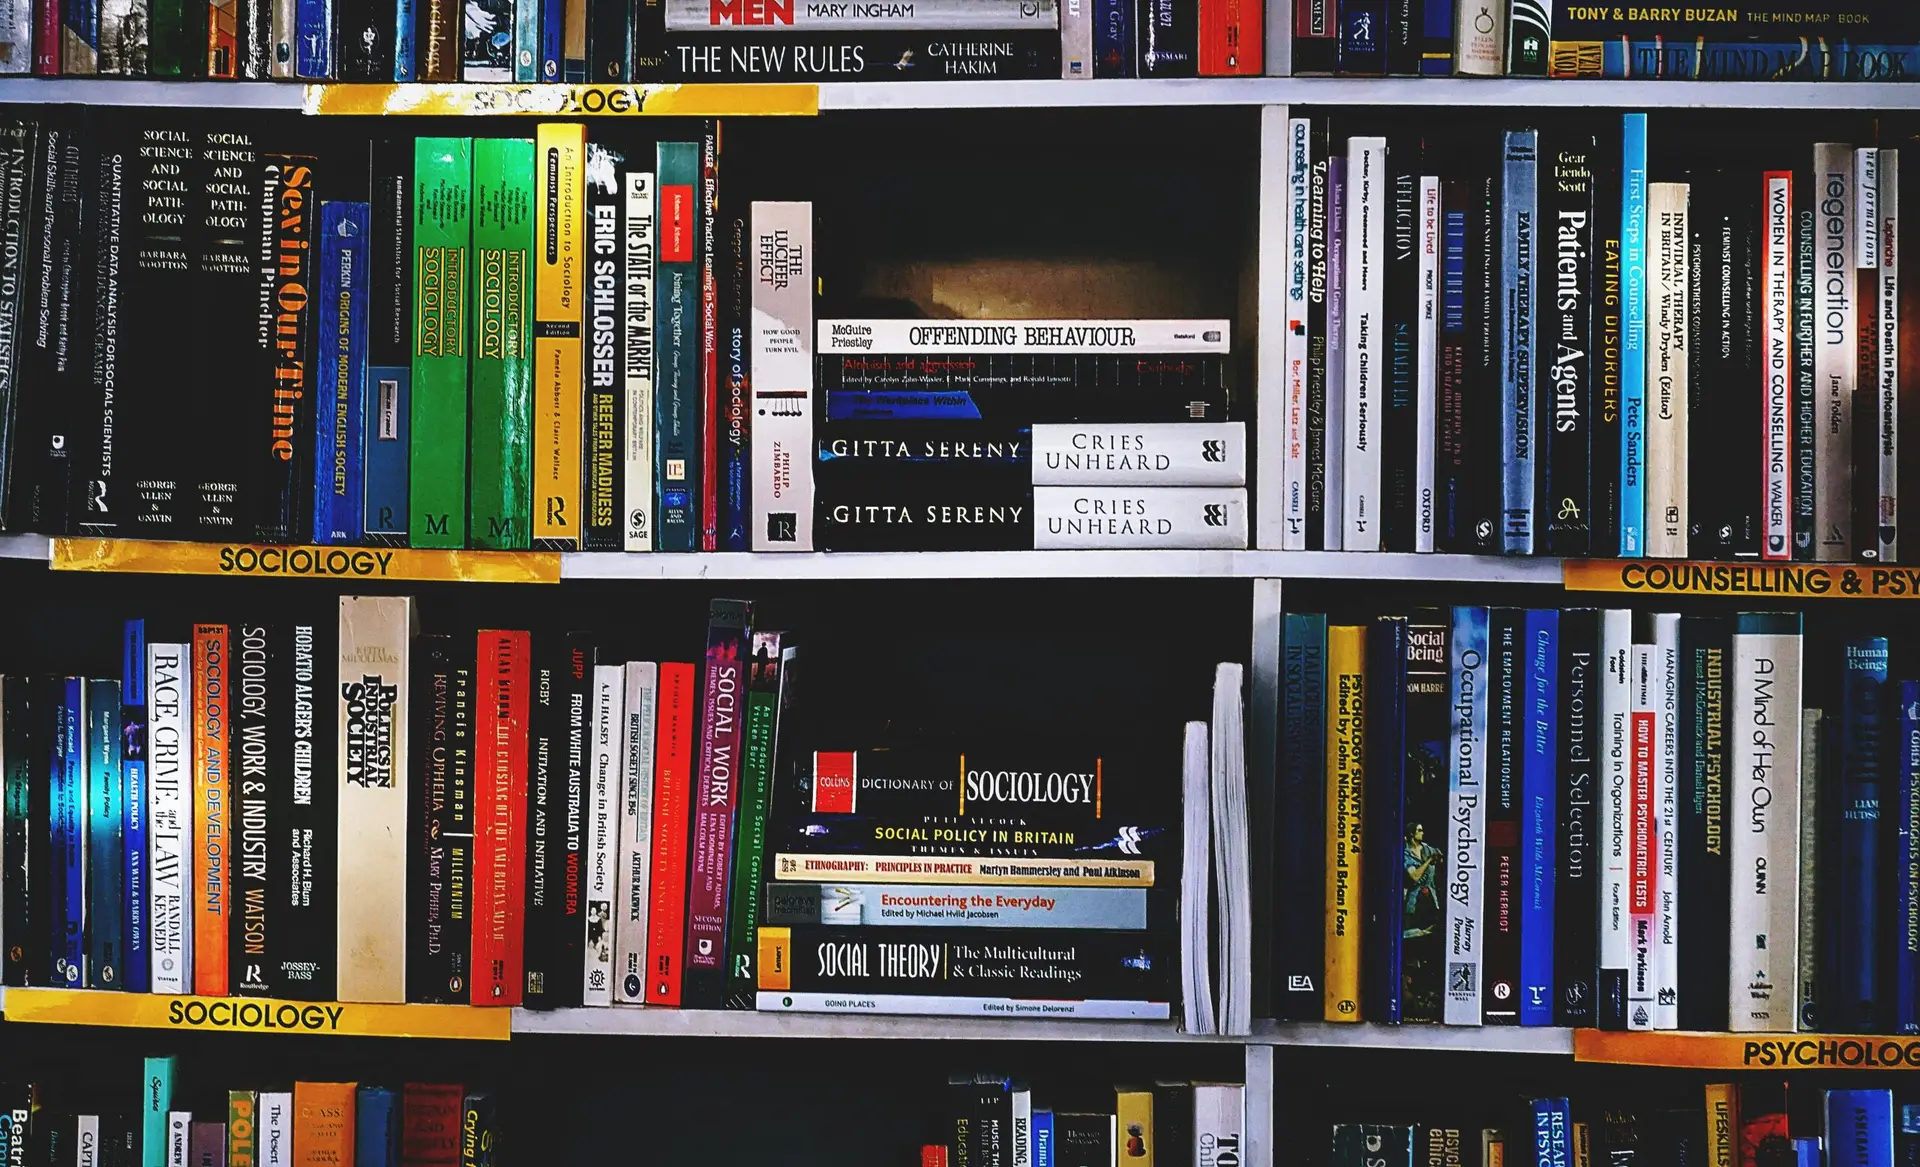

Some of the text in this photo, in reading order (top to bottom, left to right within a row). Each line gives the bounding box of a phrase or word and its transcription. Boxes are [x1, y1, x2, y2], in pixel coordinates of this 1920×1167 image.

[807, 4, 914, 17] MARY INGHAM
[1568, 7, 1737, 22] TONY & BARRY BUZAN
[1747, 12, 1869, 24] THE MIND MAP BOOK
[677, 46, 864, 73] THE NEW RULES
[928, 43, 1013, 57] CATHERINE
[945, 61, 996, 74] HAKIM
[36, 131, 59, 348] Social Skills and Personal Problem Solving
[258, 165, 279, 348] Chapman Pincher
[760, 235, 773, 286] EFFECT
[774, 229, 788, 291] LUCIFER
[789, 245, 802, 276] THE
[1308, 161, 1326, 303] Learning to Help
[1626, 169, 1643, 350] First Steps in Counselling
[1821, 173, 1848, 345] regeneration
[703, 178, 714, 353] Effective Practice Learning in Social Work
[102, 154, 122, 476] QUANTITATIVE DATA ANALYSIS FOR SOCIAL SCIENTISTS
[271, 165, 311, 460] Sex in Our Time
[423, 247, 439, 357] SOCIOLOGY
[445, 248, 458, 355] INTRODUCTORY
[592, 205, 616, 387] ERIC SCHLOSSER
[1551, 210, 1586, 433] Patients and Agents
[831, 325, 872, 337] McGuire
[831, 336, 874, 350] Priestley
[909, 326, 1136, 348] OFFENDING BEHAVIOUR
[1603, 239, 1619, 424] EATING DISORDERS
[1770, 188, 1787, 527] WOMEN IN THERAPY AND COUNSELLING WALKER
[334, 249, 352, 496] PERKIN ORIGINS OF MODERN ENGLISH SOCIETY
[1355, 313, 1369, 452] Taking Children Seriously
[1829, 374, 1842, 434] Jane Polden
[597, 394, 613, 526] REEFER MADNESS
[773, 441, 781, 499] ZIMBARDO
[781, 452, 790, 488] PHILIP
[832, 439, 1021, 458] GITTA SERENY
[1045, 453, 1171, 471] UNHEARD
[1071, 433, 1145, 451] CRIES
[1626, 397, 1642, 487] Pete Sanders
[219, 549, 393, 575] SOCIOLOGY
[1621, 564, 1831, 593] COUNSELLING
[1841, 570, 1862, 594] &
[150, 653, 179, 805] RACE, CRIME,
[293, 626, 312, 805] HORATIO ALGER'S CHILDREN
[1636, 720, 1648, 744] HOW
[205, 640, 221, 916] SOCIOLOGY AND DEVELOPMENT
[1450, 649, 1481, 907] Occupational Psychology
[1636, 746, 1648, 758] TO
[1706, 648, 1722, 855] INDUSTRIAL PSYCHOLOGY
[241, 627, 266, 954] SOCIOLOGY, WORK & INDUSTRY WATSON
[565, 648, 584, 915] JUPP FROM WHITE AUSTRALIA TO WOOMERA
[862, 777, 954, 791] DICTIONARY OF
[966, 770, 1094, 804] SOCIOLOGY
[1636, 761, 1648, 801] MASTER
[155, 811, 168, 829] the
[167, 809, 182, 830] and
[875, 827, 1075, 845] SOCIAL POLICY IN BRITAIN
[1634, 804, 1647, 877] PSYCHOMETRIC
[155, 832, 179, 889] LAW
[881, 893, 1055, 912] Encountering the Everyday
[882, 910, 903, 918] Edited
[905, 910, 914, 920] by
[916, 910, 944, 919] Michael
[967, 910, 999, 920] Jacobsen
[1635, 880, 1647, 908] TESTS
[154, 894, 167, 954] KENNEDY
[168, 894, 181, 954] RANDALL
[818, 942, 941, 979] SOCIAL THEORY
[168, 1001, 344, 1029] SOCIOLOGY
[270, 1105, 280, 1163] The Desert
